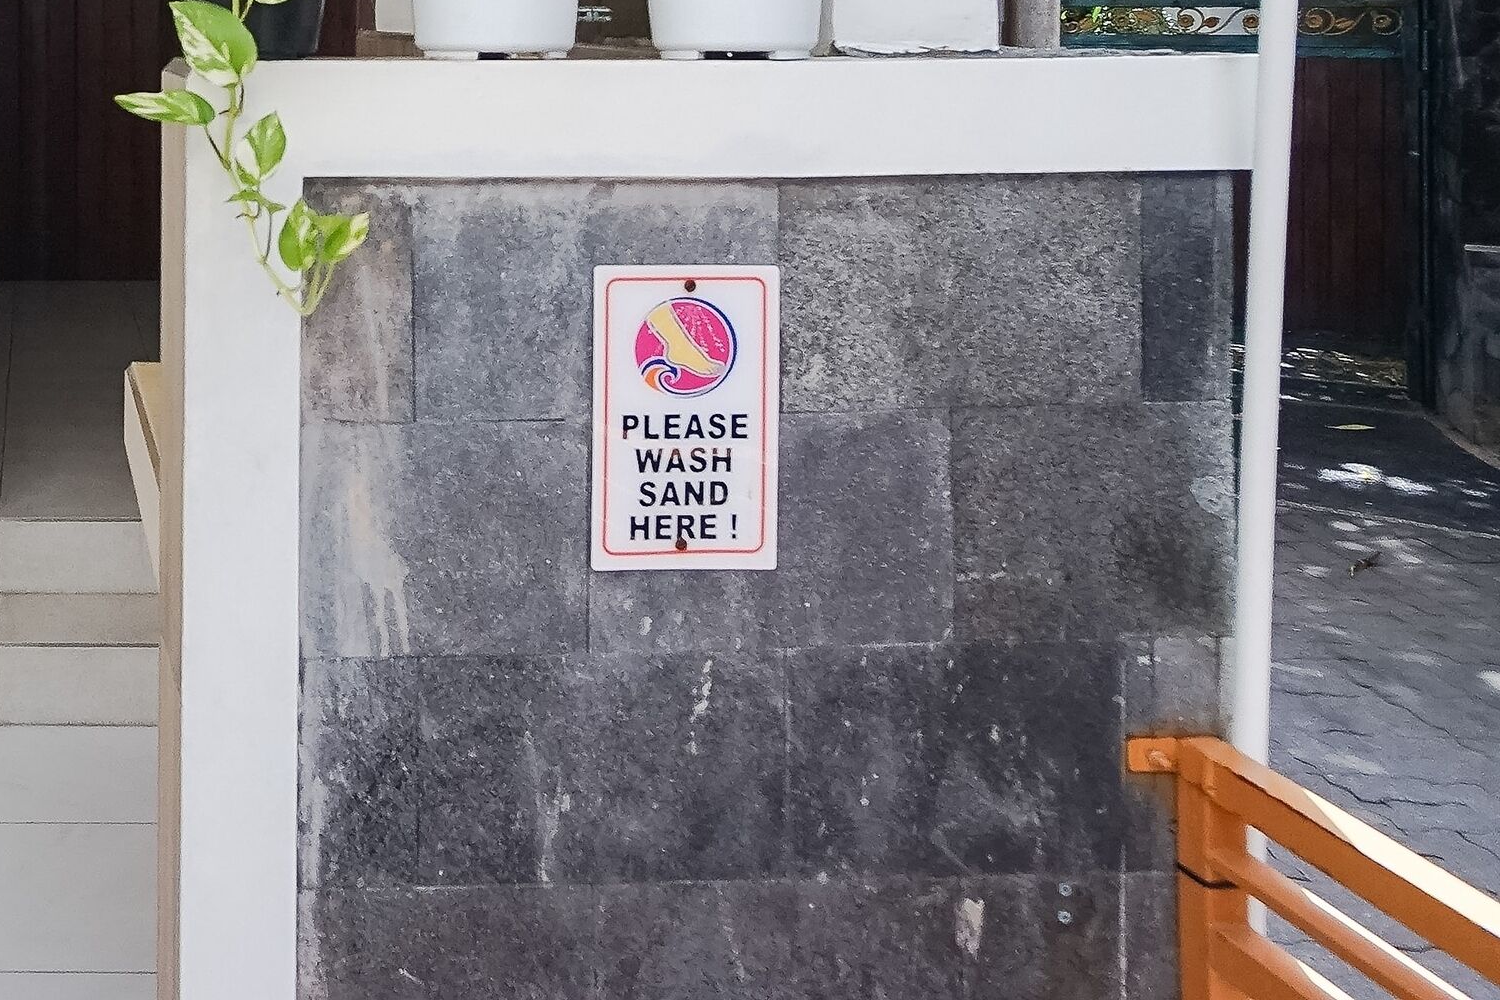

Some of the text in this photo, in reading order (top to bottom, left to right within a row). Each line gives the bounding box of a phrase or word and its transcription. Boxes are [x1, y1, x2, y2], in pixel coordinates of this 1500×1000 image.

[621, 413, 749, 440] PLEASE
[635, 447, 733, 474] WASH
[638, 481, 730, 507] SAND
[629, 513, 718, 541] HERE
